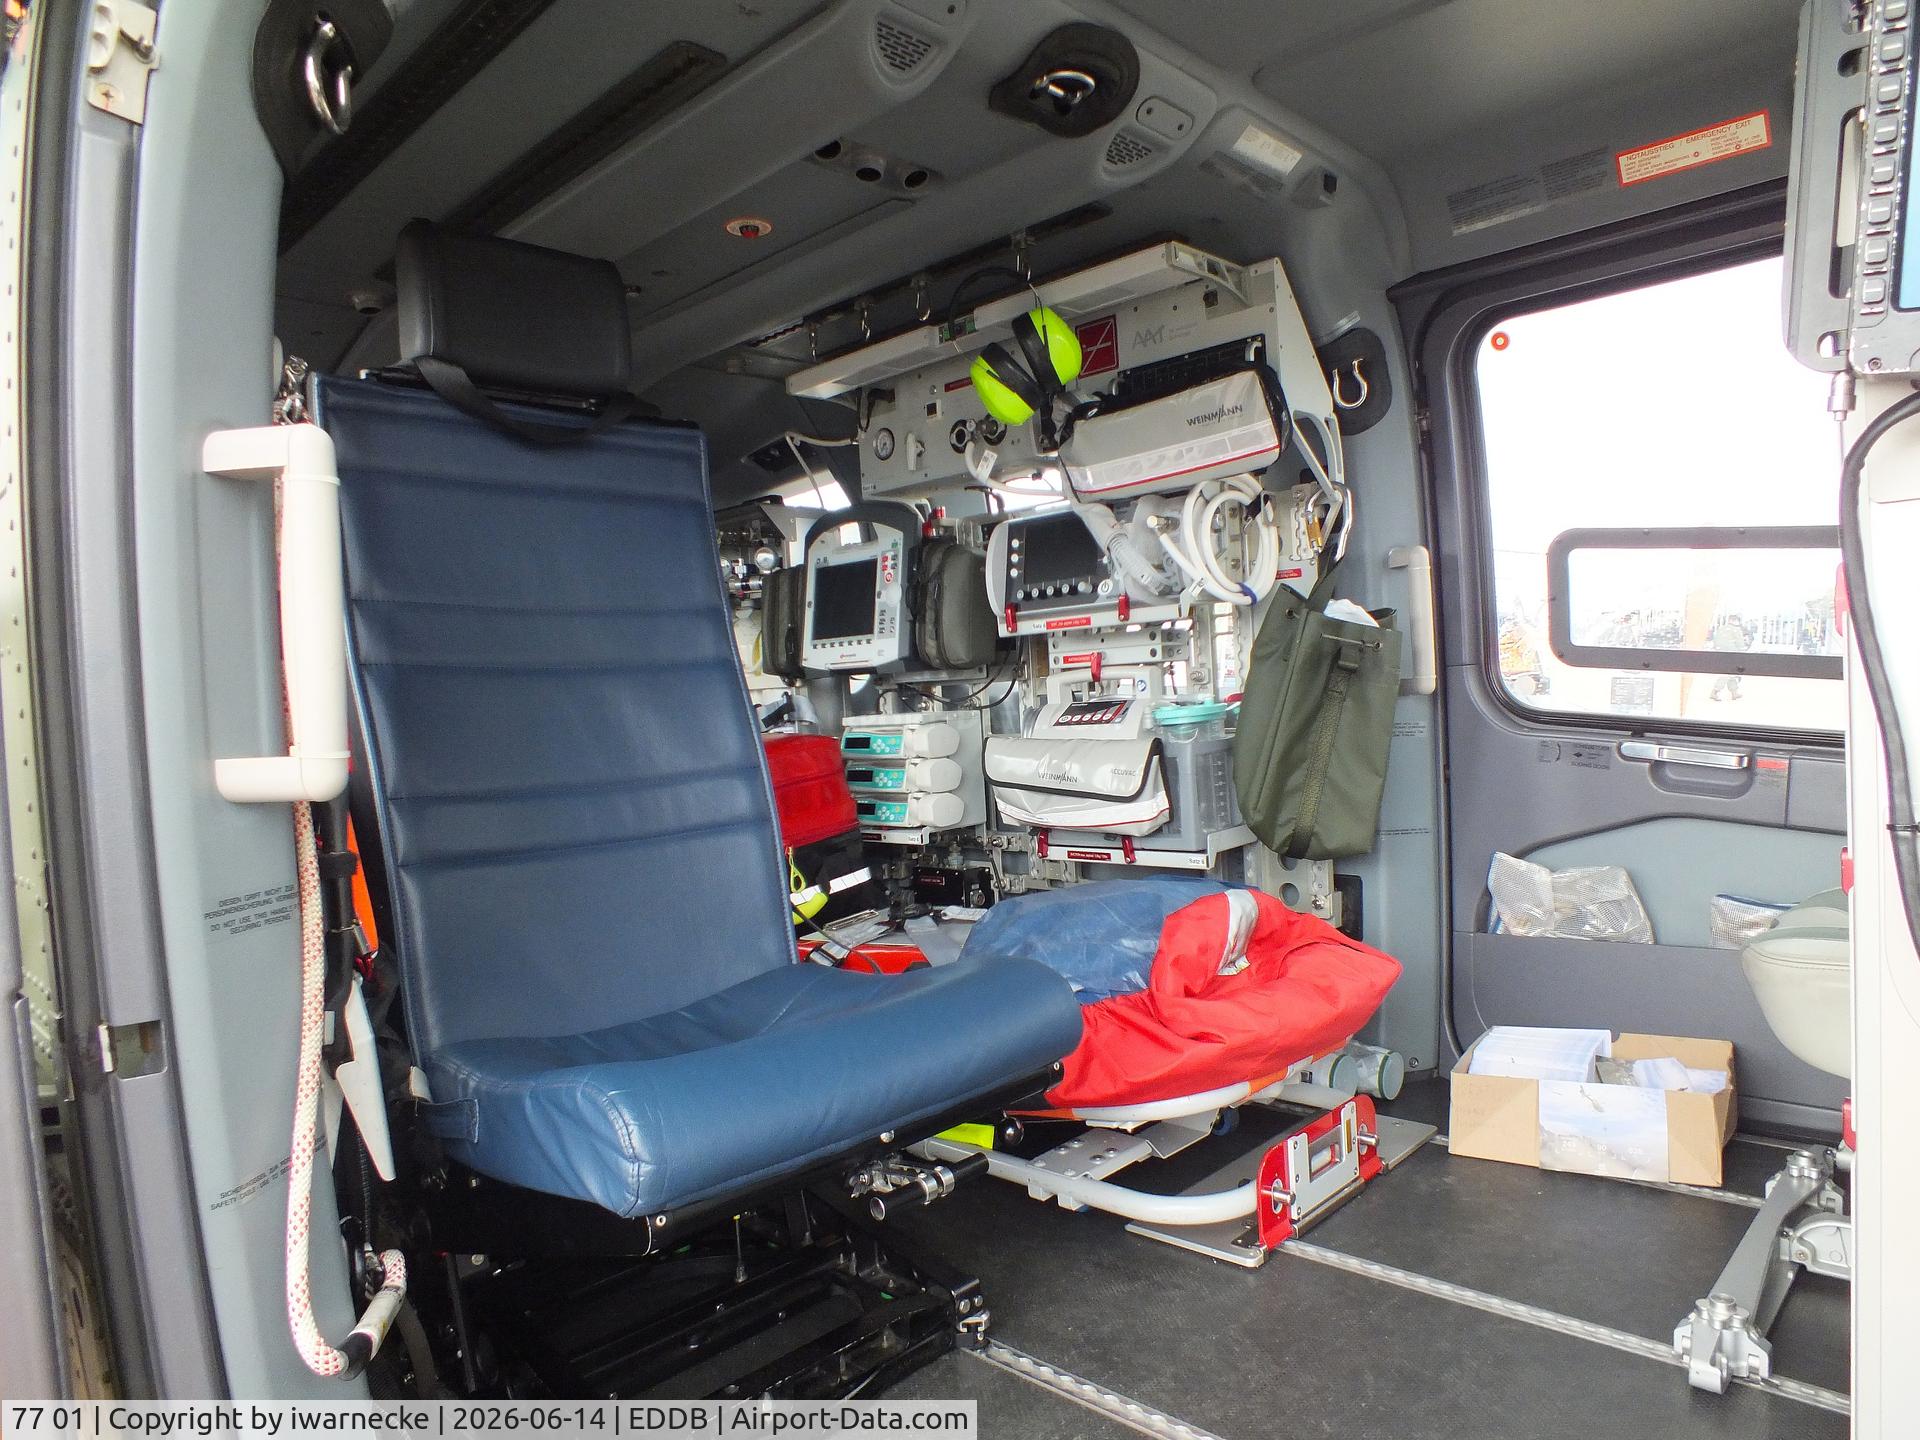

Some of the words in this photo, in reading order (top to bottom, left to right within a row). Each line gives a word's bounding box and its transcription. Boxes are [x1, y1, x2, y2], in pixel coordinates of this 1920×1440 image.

[1625, 142, 1675, 161] NOTAUSSTIEG
[1685, 126, 1732, 144] EMERGENCY
[1735, 119, 1751, 130] EXIT
[1038, 771, 1078, 784] WEINMANN
[239, 915, 251, 925] USE
[210, 1197, 237, 1211] SAFETY
